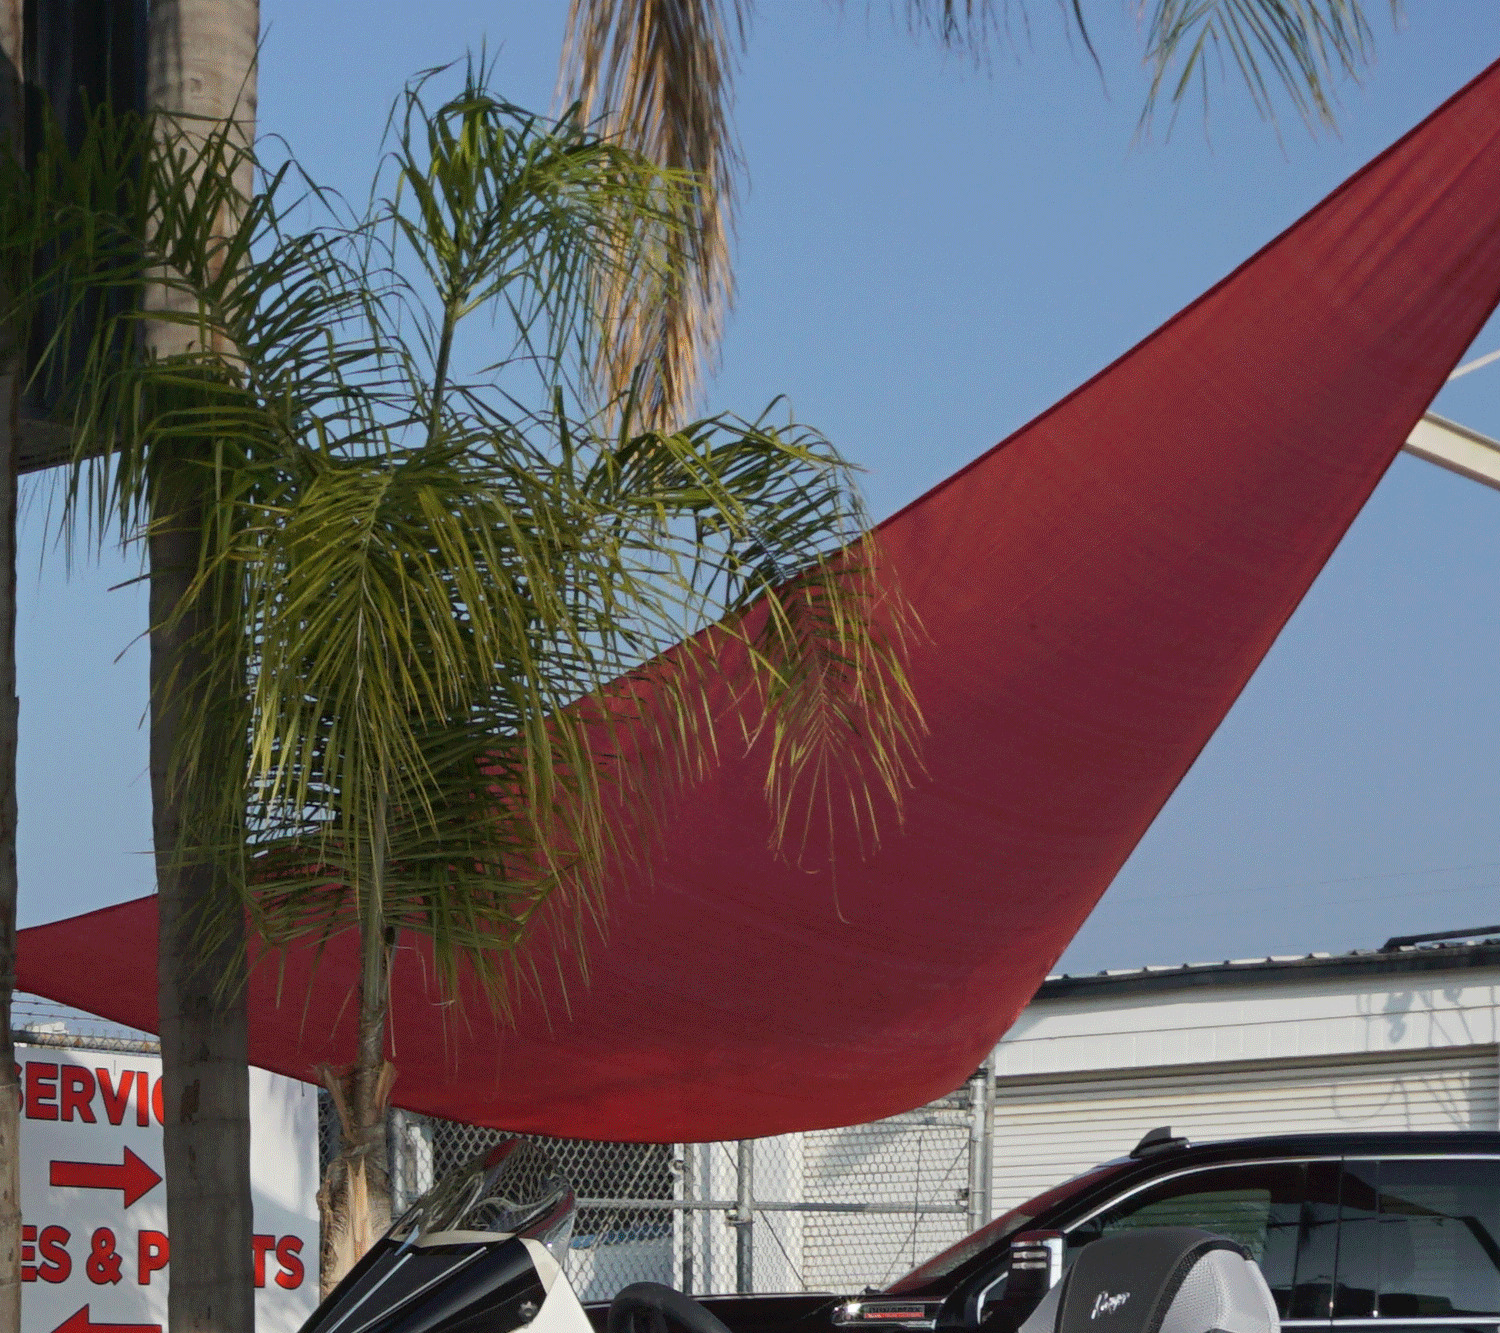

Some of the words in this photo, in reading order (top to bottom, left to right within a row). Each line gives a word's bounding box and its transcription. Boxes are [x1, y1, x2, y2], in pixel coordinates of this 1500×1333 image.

[16, 1061, 164, 1127] ERVI
[85, 1226, 122, 1286] &
[137, 1229, 305, 1290] PTS
